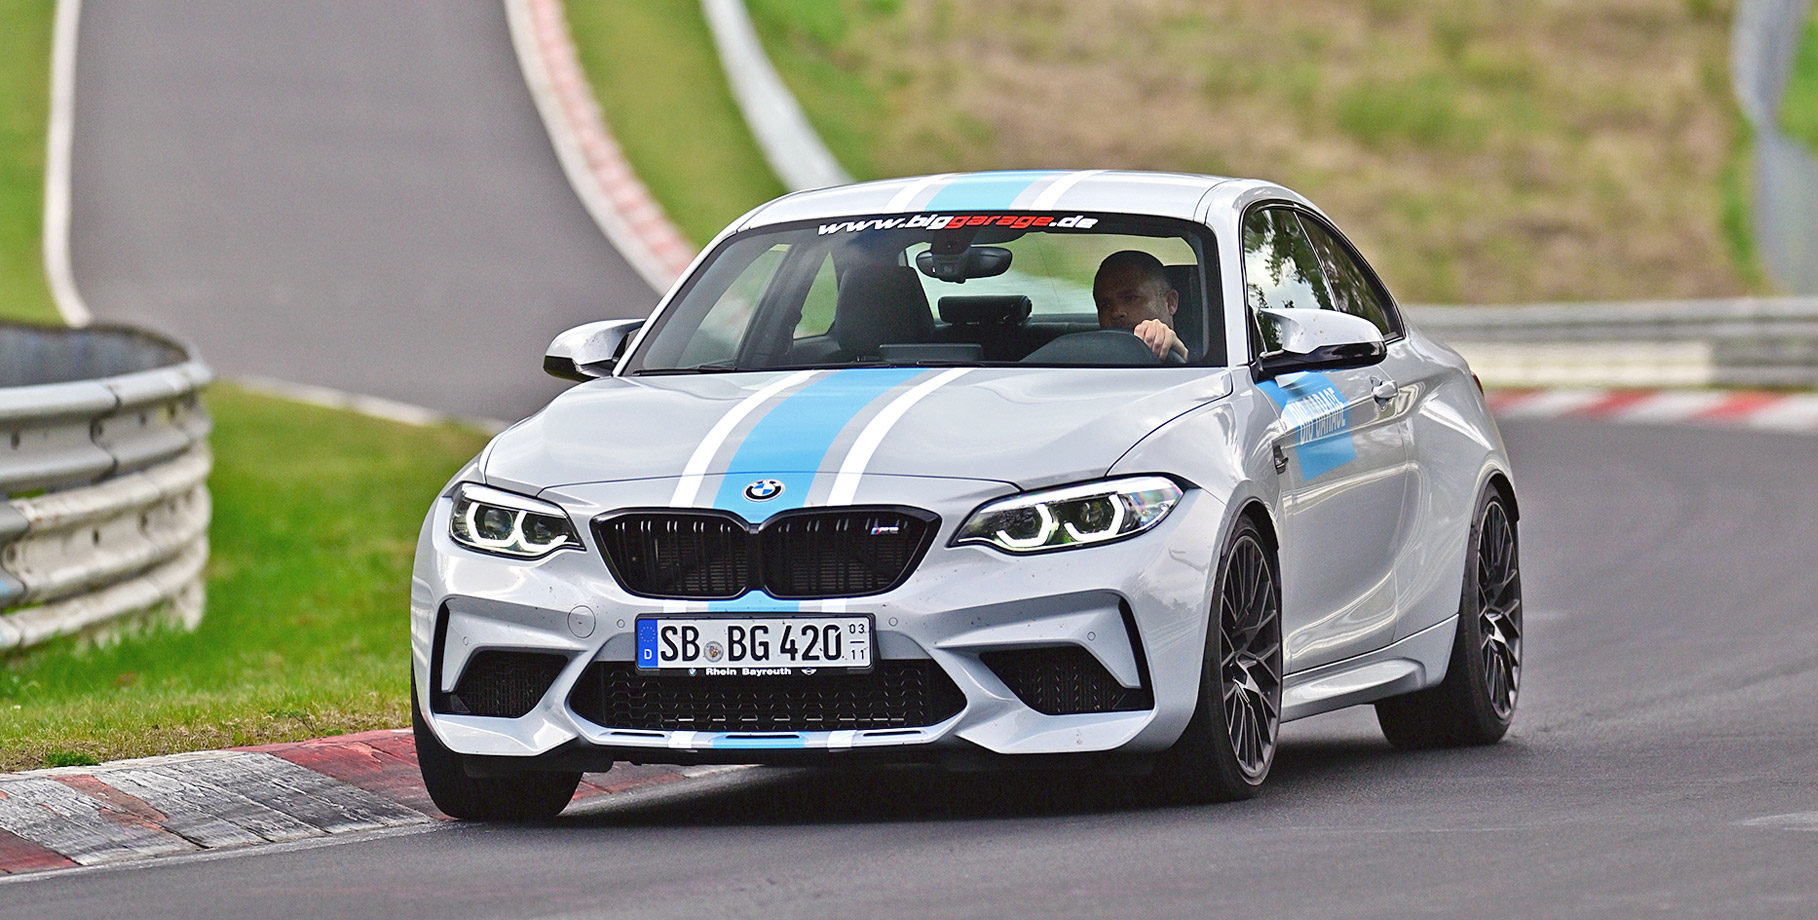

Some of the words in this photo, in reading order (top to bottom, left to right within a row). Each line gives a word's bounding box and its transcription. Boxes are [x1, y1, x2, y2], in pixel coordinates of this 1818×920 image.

[818, 214, 1098, 235] www.biggarage.de
[848, 623, 865, 634] 03
[660, 625, 700, 662] SB
[728, 625, 771, 662] BG
[780, 624, 842, 661] 420
[643, 649, 653, 660] D
[851, 650, 865, 660] 11
[705, 667, 737, 676] Rhein
[742, 667, 792, 677] Bayreuth
